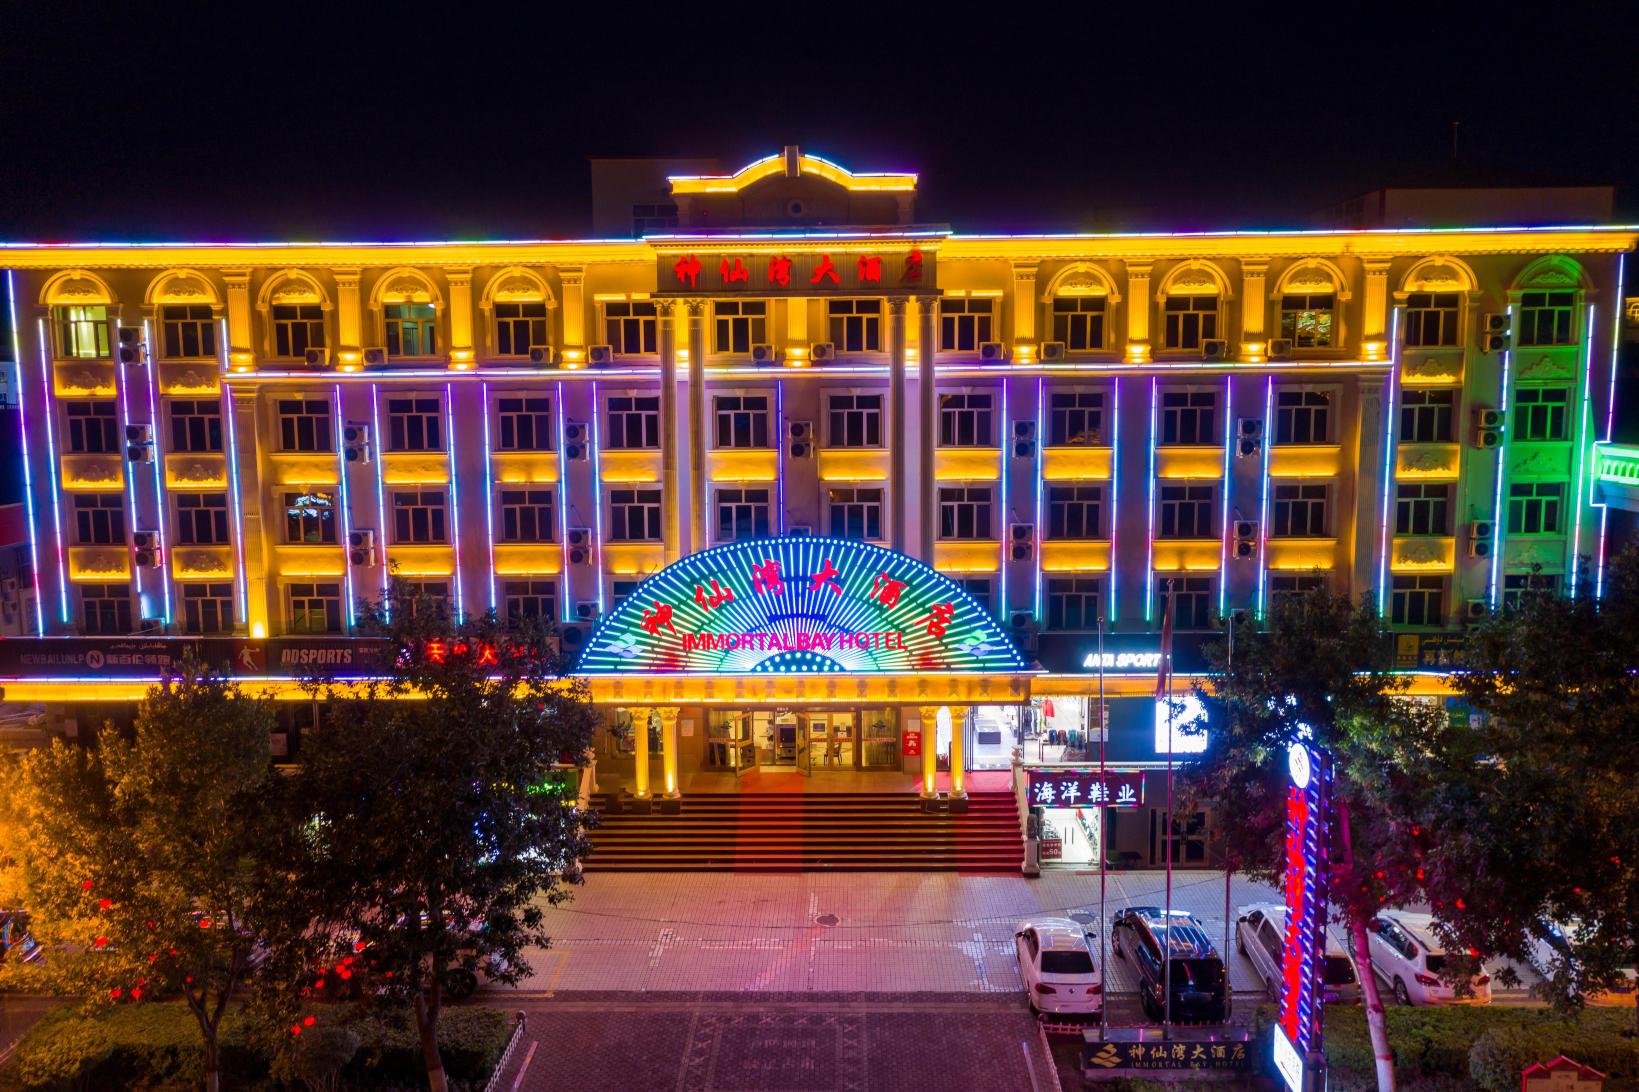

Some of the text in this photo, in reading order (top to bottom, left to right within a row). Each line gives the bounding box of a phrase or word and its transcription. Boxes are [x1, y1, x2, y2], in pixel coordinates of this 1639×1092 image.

[673, 251, 922, 288] 神仙湾大酒店
[640, 559, 955, 639] 神仙湾大酒店
[682, 632, 909, 650] IMMORTAL BAY HOTEL
[1083, 653, 1169, 667] ANTA SPORT
[1034, 781, 1137, 804] 海洋鞋业
[1129, 1043, 1246, 1061] 神仙湾大酒店
